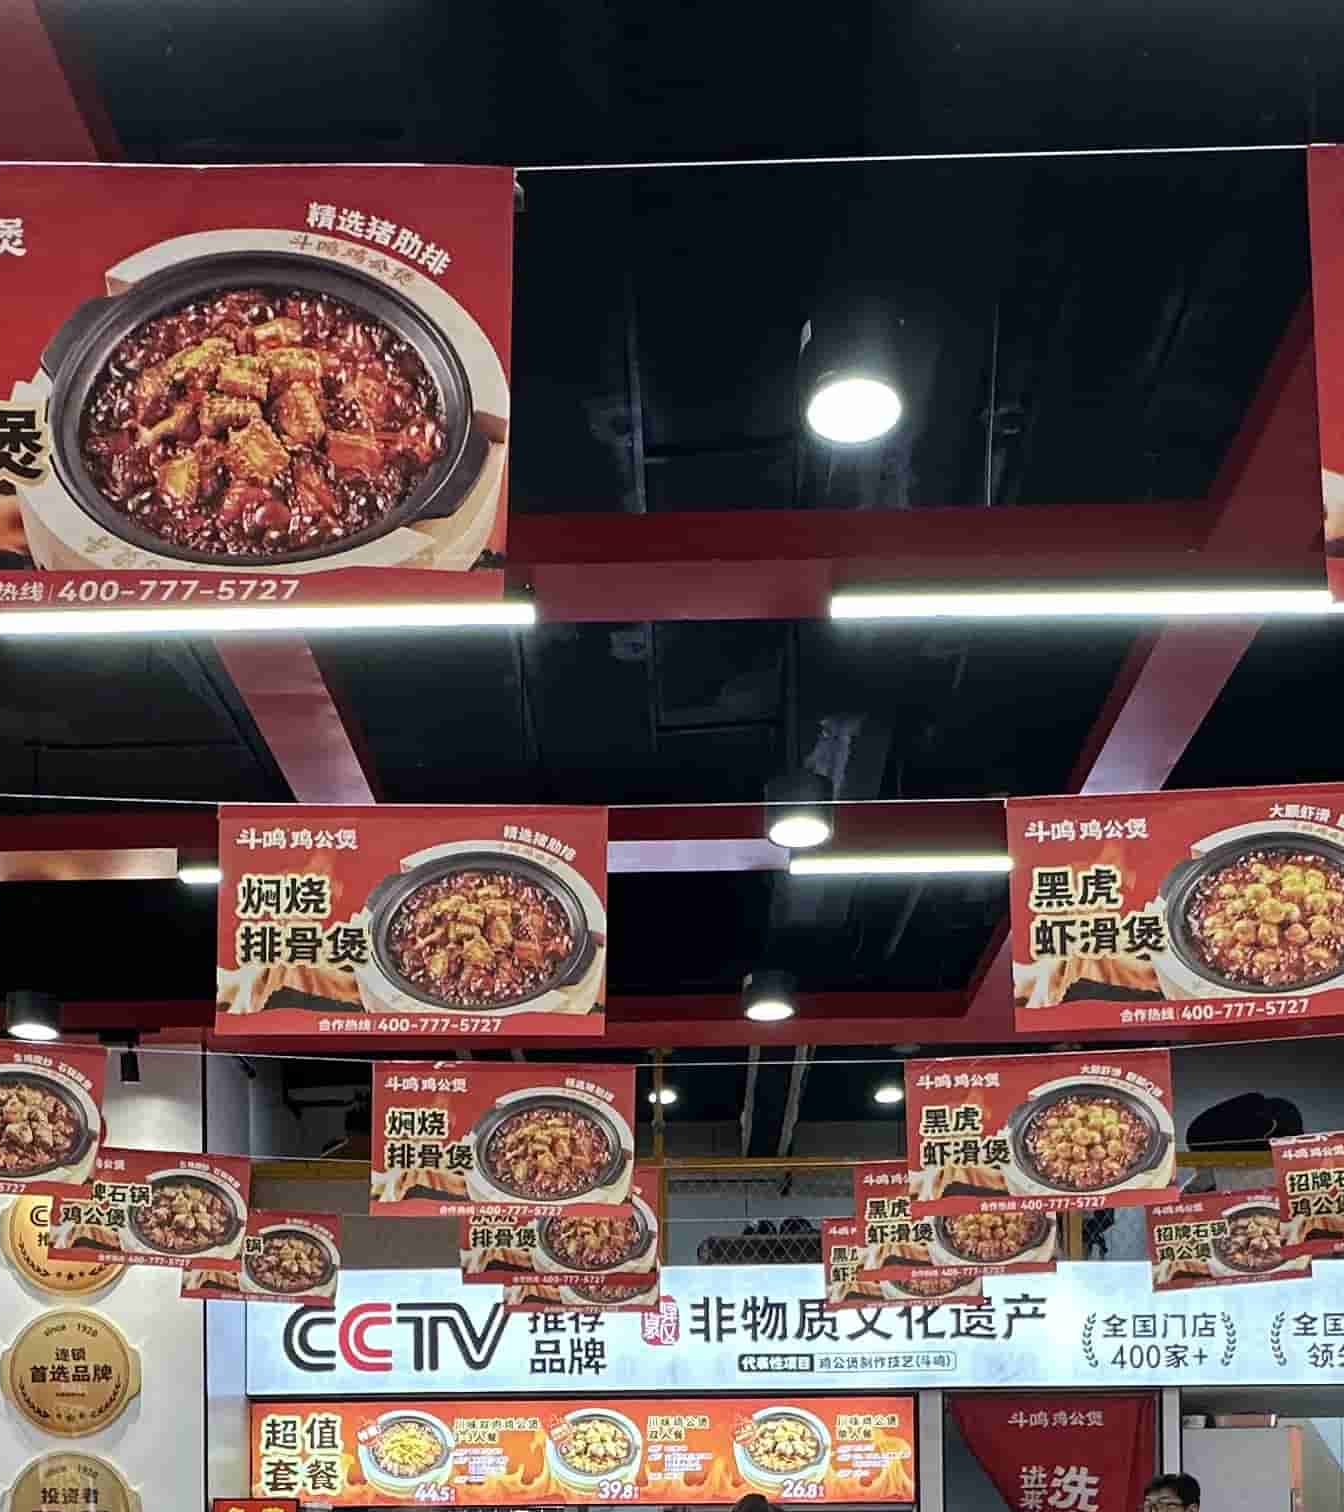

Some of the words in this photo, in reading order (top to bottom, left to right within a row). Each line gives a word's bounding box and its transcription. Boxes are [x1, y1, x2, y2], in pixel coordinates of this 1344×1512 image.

[306, 202, 452, 277] 精选猪肋排
[58, 579, 299, 601] 400-777-5727
[236, 828, 358, 850] 斗鸣鸡公煲
[1025, 818, 1149, 843] 斗鸣鸡公煲
[240, 876, 328, 916] 焖烧
[1035, 868, 1120, 908] 黑虎
[240, 926, 368, 964] 排骨煲
[1035, 915, 1165, 960] 虾滑煲
[1181, 1000, 1309, 1020] 400-777-5727
[378, 1018, 501, 1032] 400-777-5727
[388, 1112, 445, 1136] 焖烧
[922, 1108, 980, 1134] 黑虎
[388, 1144, 473, 1169] 排骨煲
[922, 1140, 1010, 1167] 虾滑煲
[62, 1206, 125, 1231] 鸡公煲
[472, 1229, 536, 1247] 排骨煲
[868, 1224, 933, 1243] 虾滑煲
[690, 1294, 1047, 1342] 非物质文化遗产
[1102, 1313, 1218, 1339] 全国门店
[283, 1302, 511, 1372] CCTV
[529, 1337, 607, 1376] 品牌
[1111, 1343, 1209, 1369] 400家+
[29, 1365, 113, 1384] 首选品牌
[265, 1417, 339, 1450] 超值
[264, 1459, 339, 1493] 套餐
